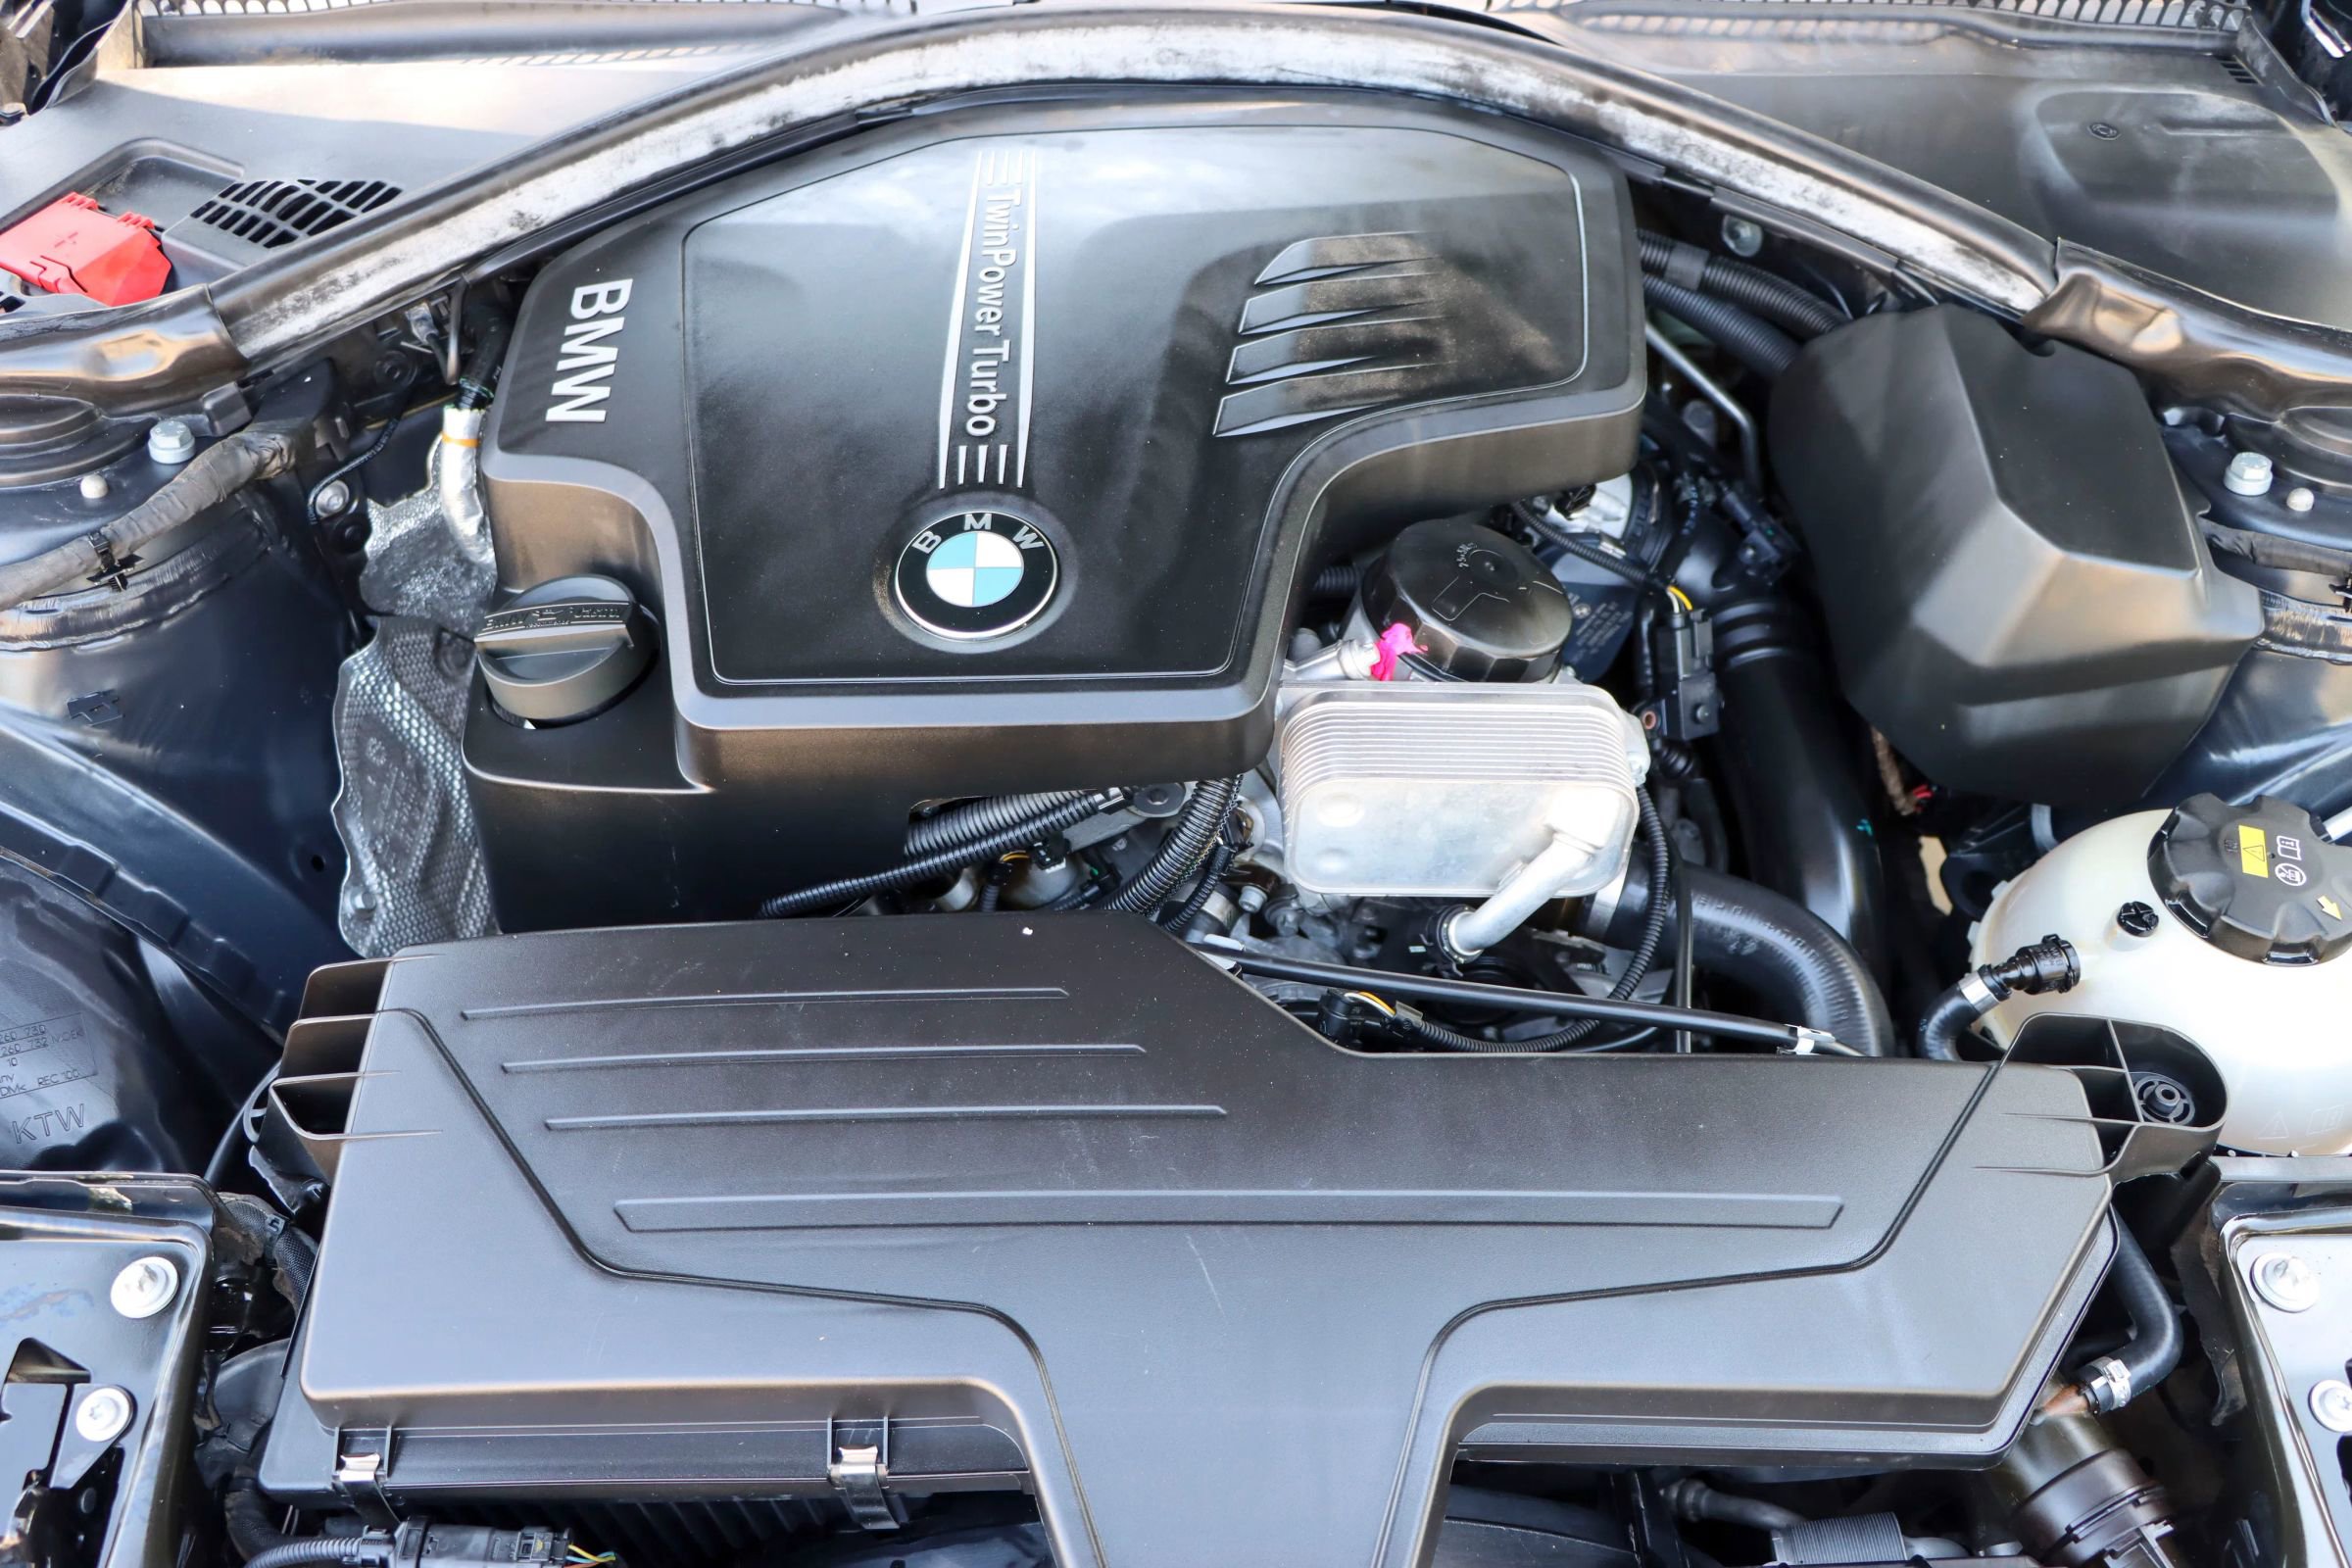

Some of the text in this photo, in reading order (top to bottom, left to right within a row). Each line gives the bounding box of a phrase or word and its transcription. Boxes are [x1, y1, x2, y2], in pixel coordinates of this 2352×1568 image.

[546, 278, 634, 422] BMW
[966, 188, 1022, 437] TwinPower Turbo
[911, 513, 1045, 555] BMW
[12, 1102, 85, 1145] KTW
